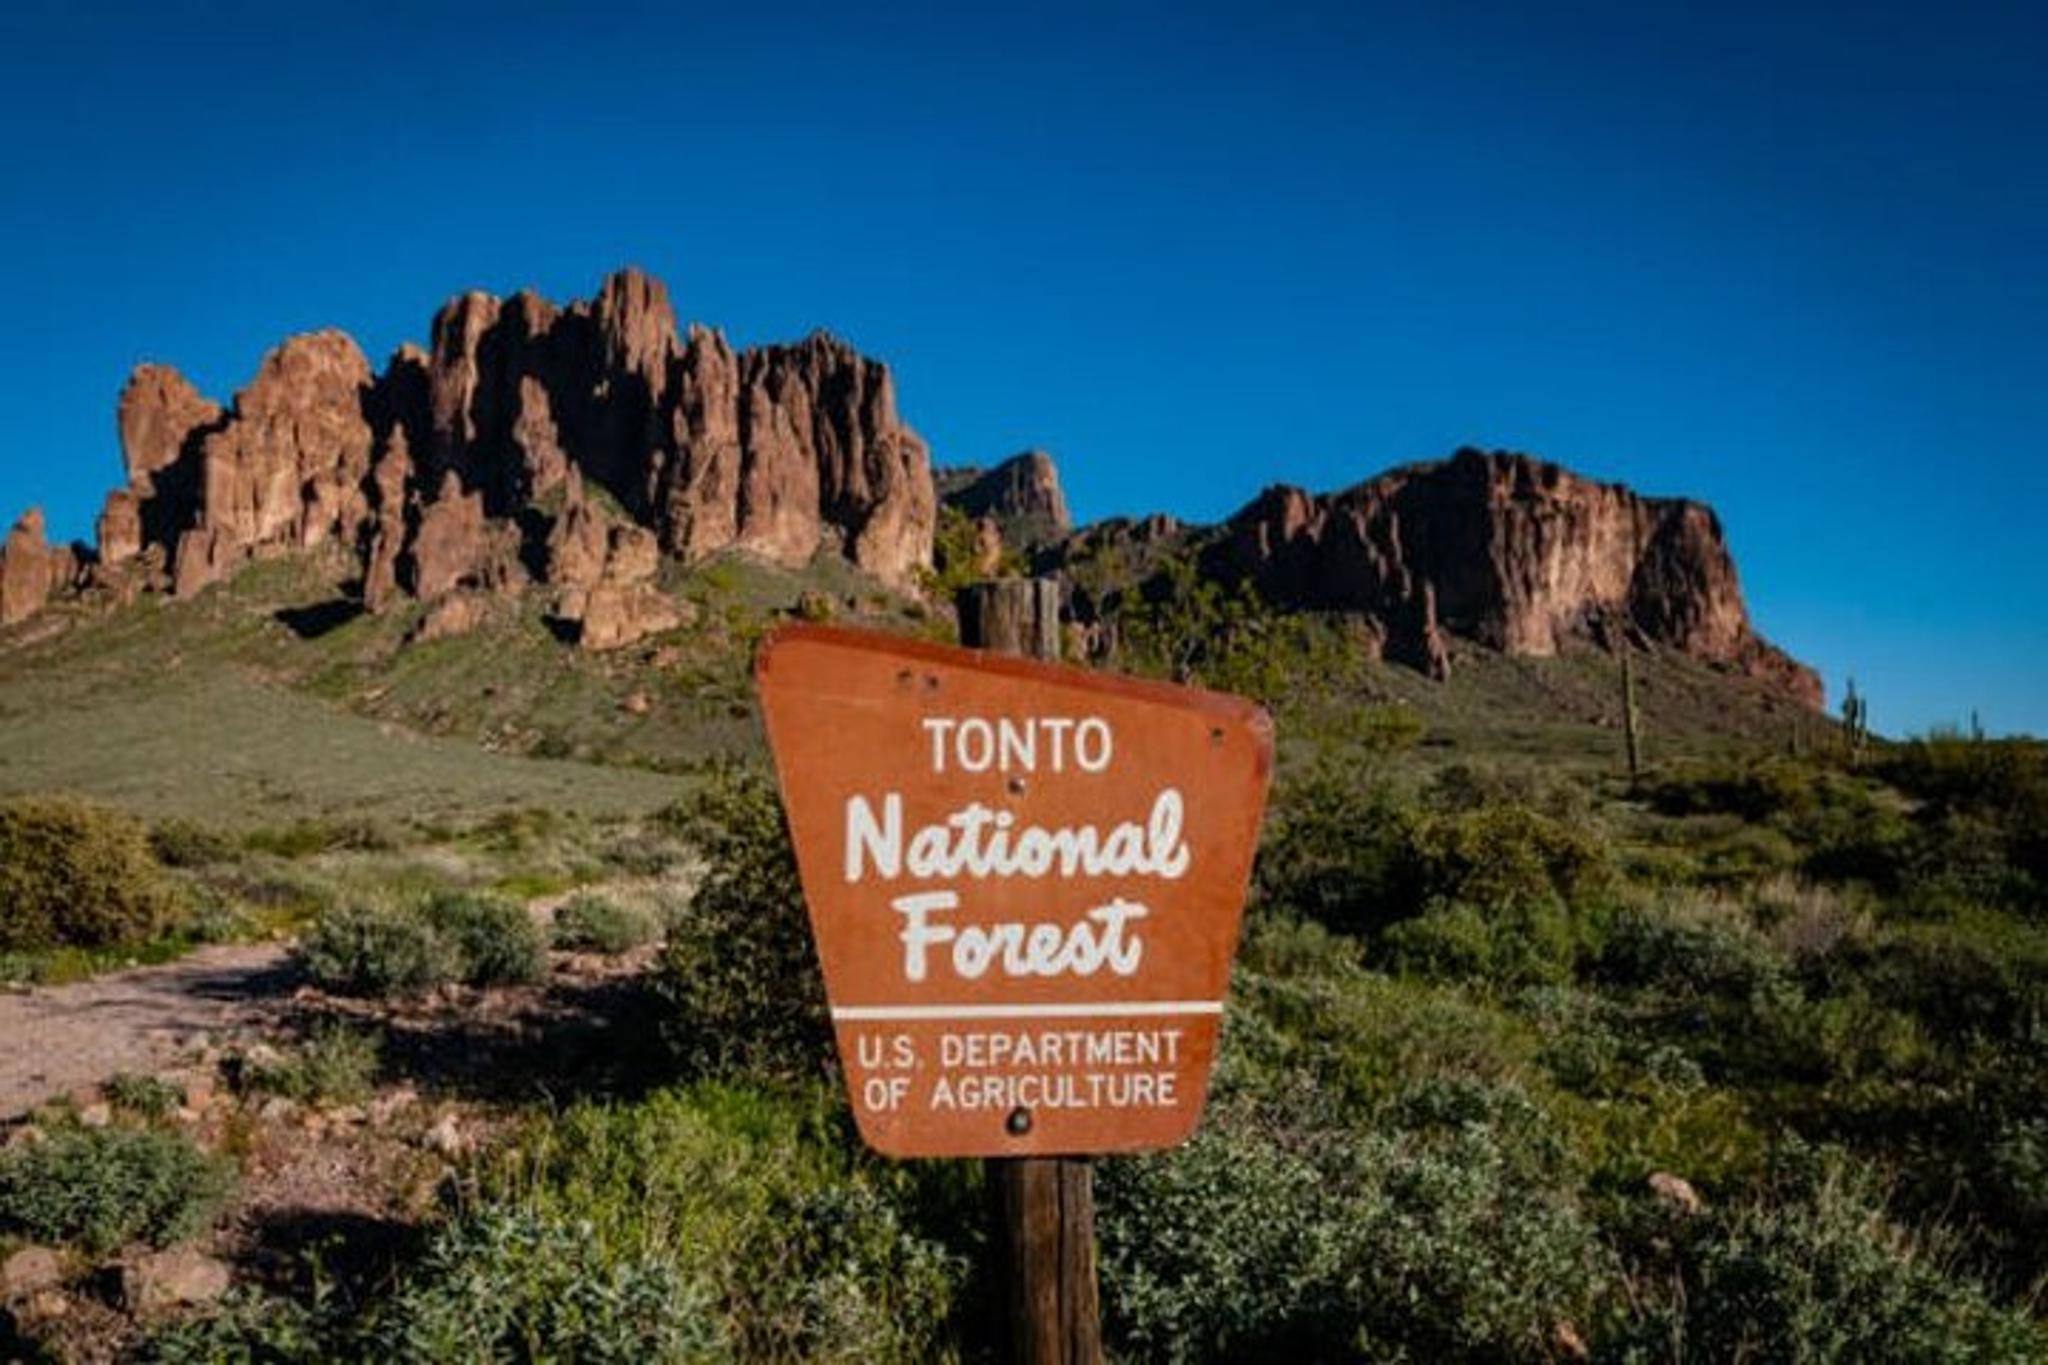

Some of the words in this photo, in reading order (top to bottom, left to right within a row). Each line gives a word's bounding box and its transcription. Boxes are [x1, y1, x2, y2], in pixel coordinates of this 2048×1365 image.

[922, 717, 1114, 773] TONTO
[844, 787, 1191, 883] National
[890, 889, 1149, 983] Forest
[857, 1034, 925, 1070] U.S.
[940, 1030, 1183, 1068] DEPARTMENT
[863, 1076, 911, 1112] OF
[930, 1072, 1178, 1111] AGRICULTURE
